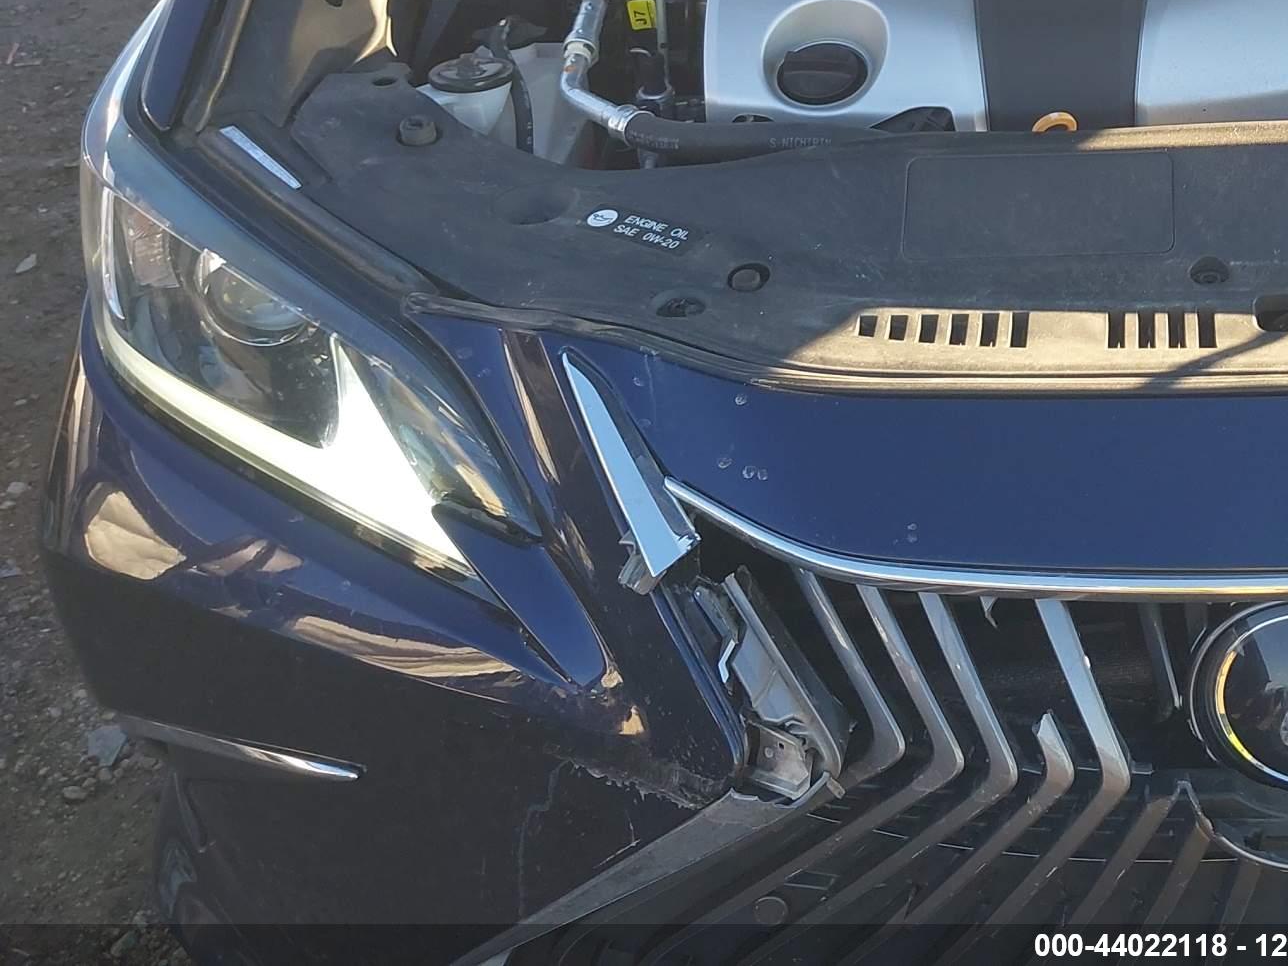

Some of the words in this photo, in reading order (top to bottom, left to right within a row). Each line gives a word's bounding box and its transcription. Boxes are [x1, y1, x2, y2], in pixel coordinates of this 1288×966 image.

[613, 224, 640, 237] SAE
[642, 232, 680, 249] 0W-20
[624, 215, 669, 232] ENGINE
[670, 228, 689, 240] OIL
